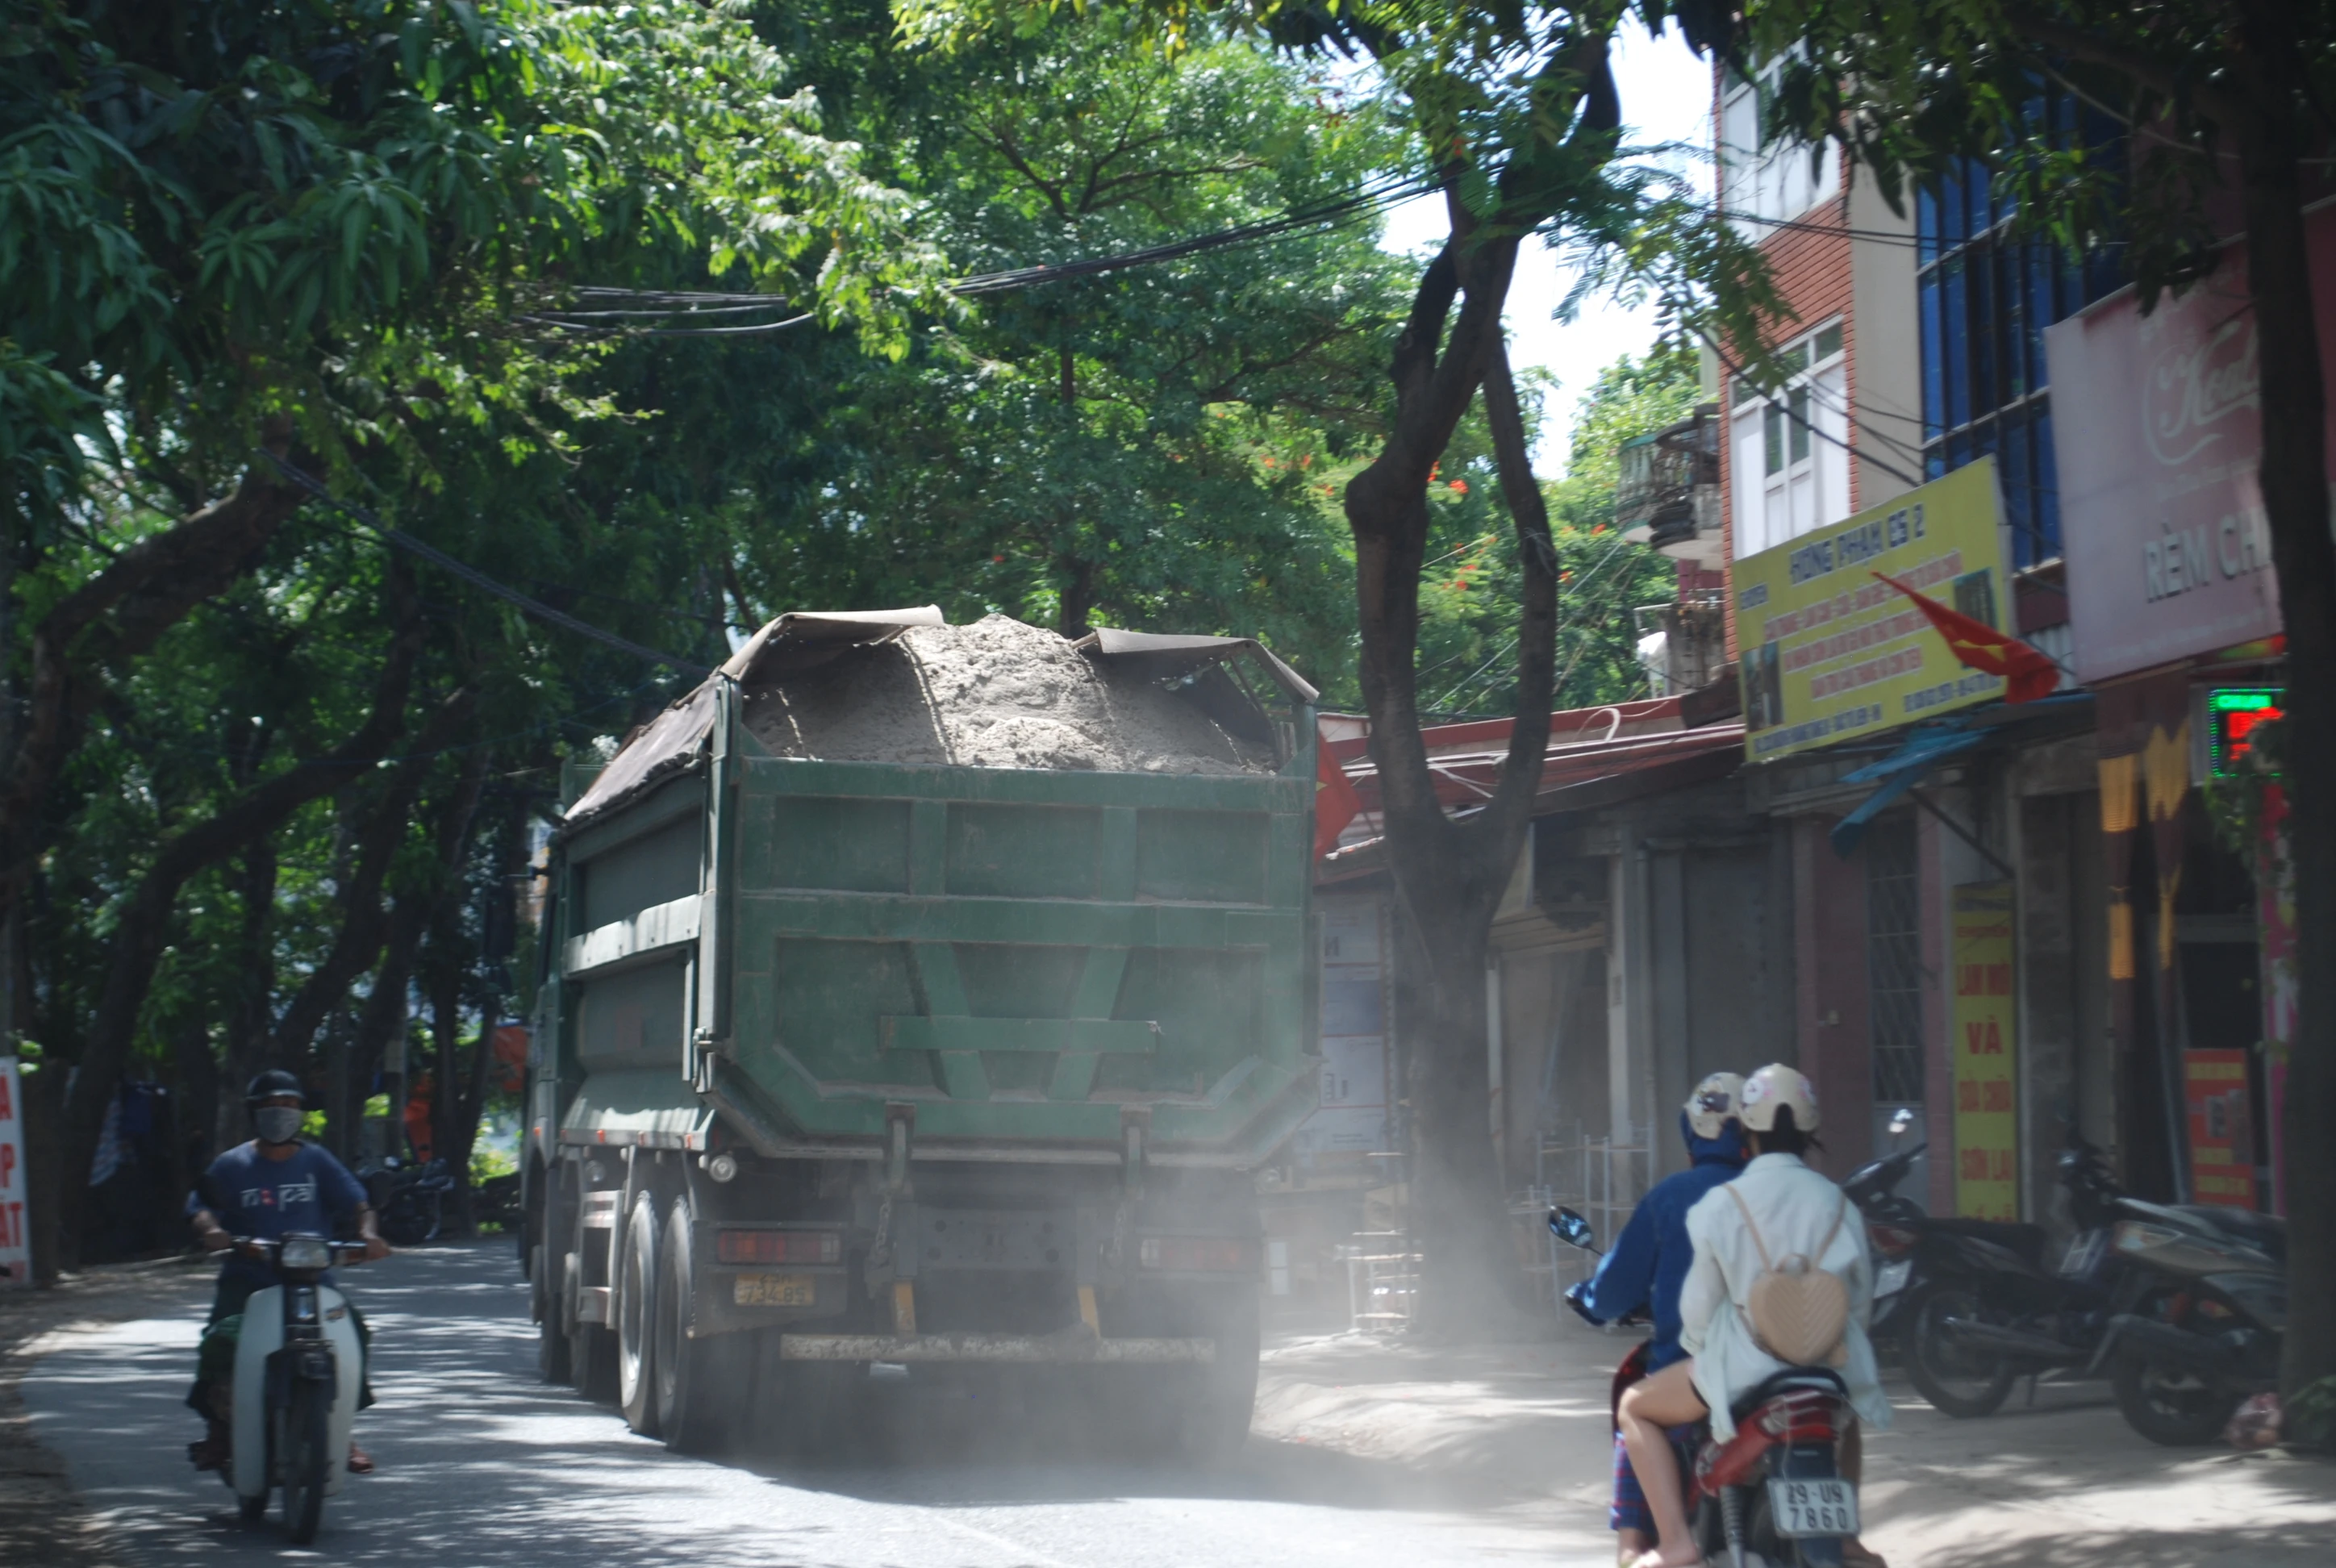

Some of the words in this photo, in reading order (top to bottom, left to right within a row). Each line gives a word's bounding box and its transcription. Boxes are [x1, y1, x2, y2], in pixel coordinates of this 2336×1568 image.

[1913, 503, 1925, 539] 2
[2142, 519, 2210, 603] RÈM
[1966, 1015, 2004, 1055] VÀ
[240, 1173, 317, 1212] nepal
[1789, 1507, 1847, 1529] 7860
